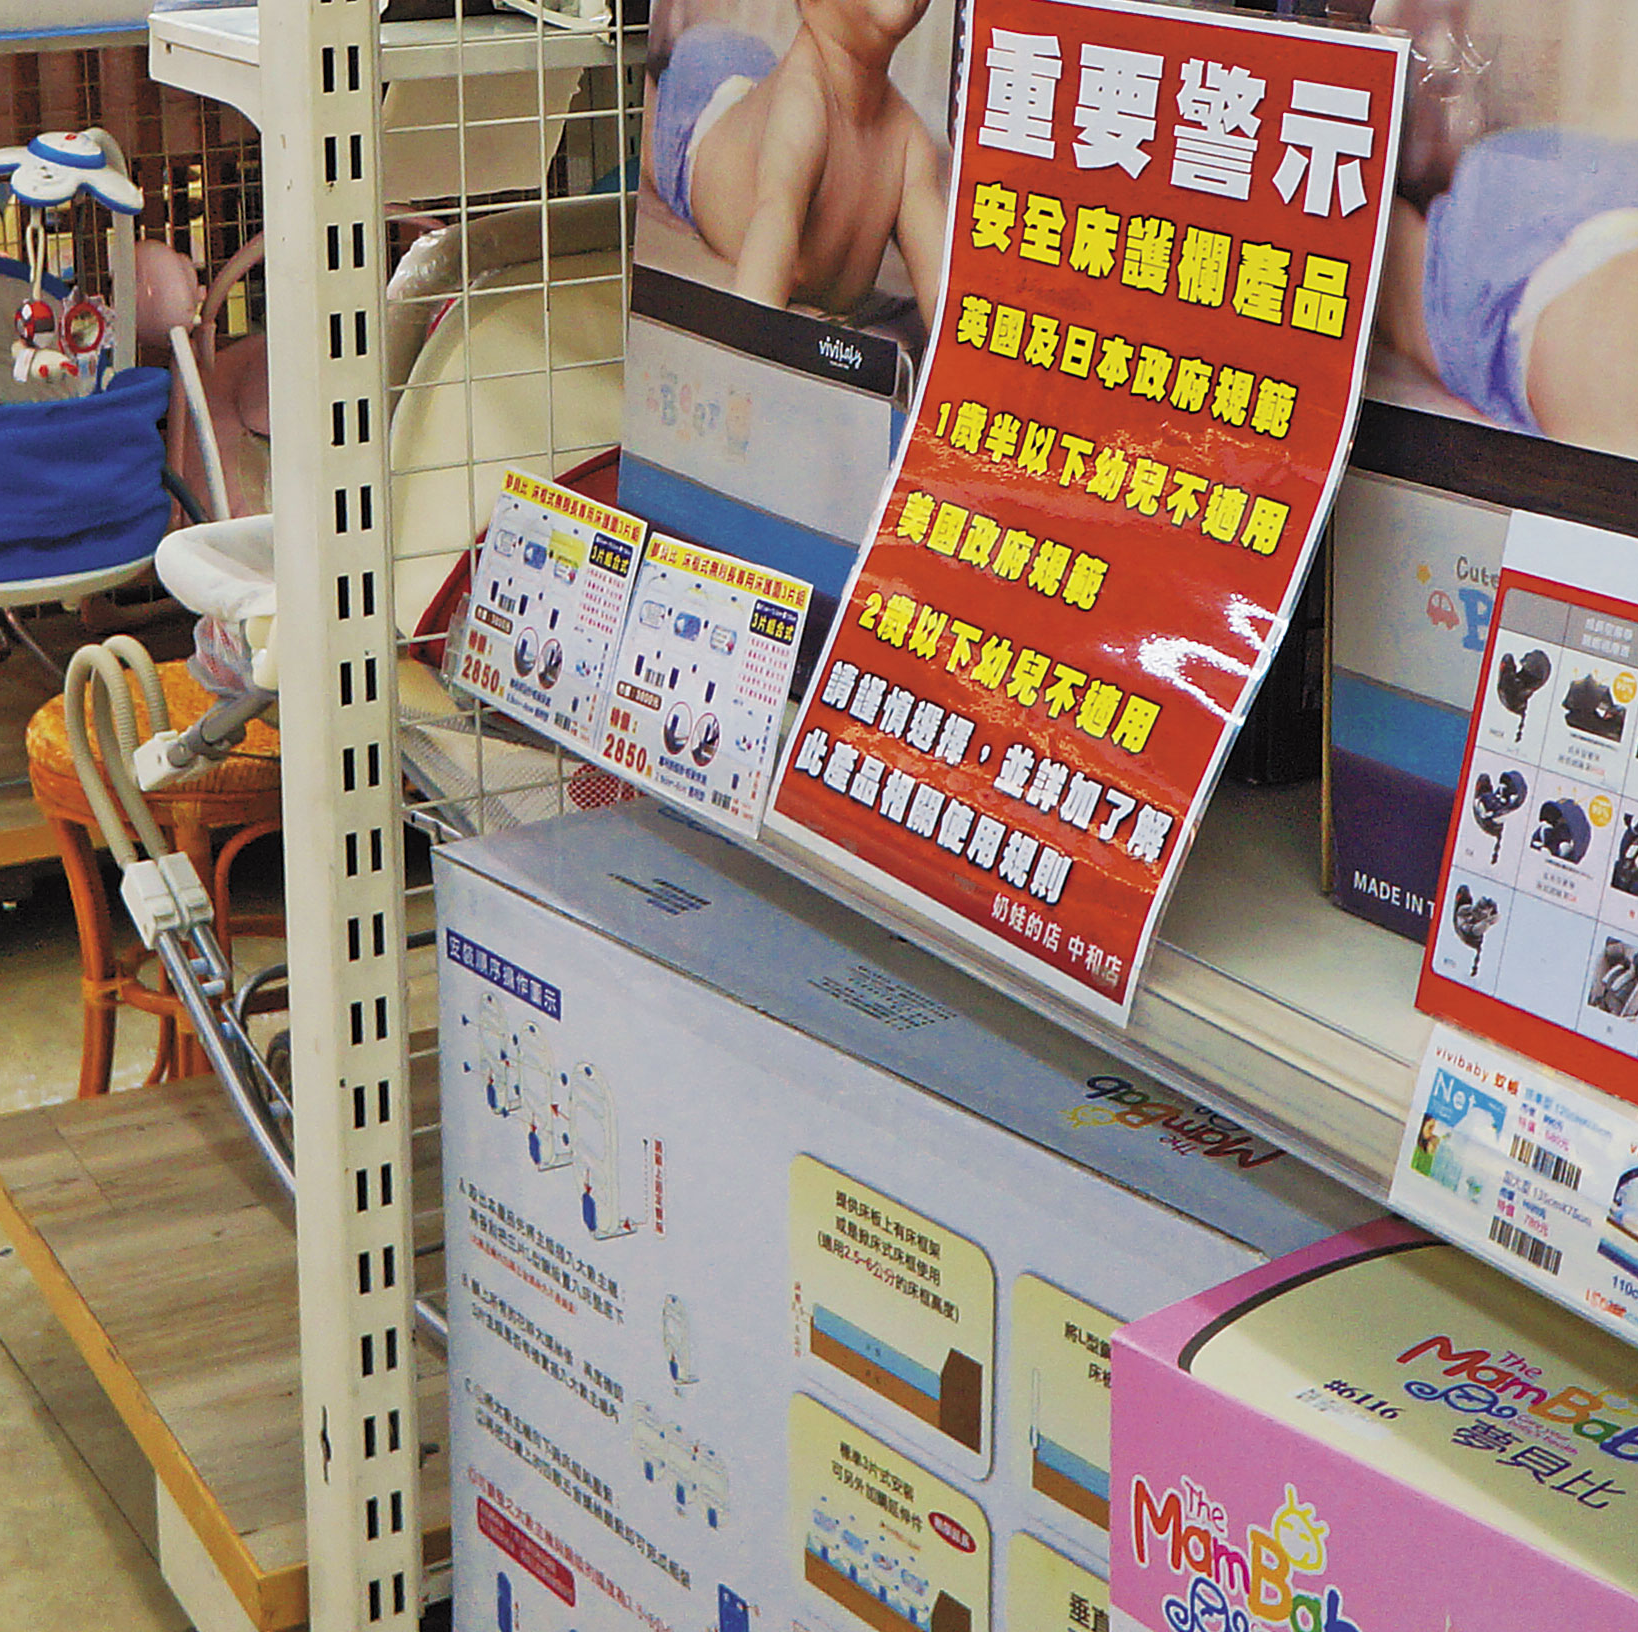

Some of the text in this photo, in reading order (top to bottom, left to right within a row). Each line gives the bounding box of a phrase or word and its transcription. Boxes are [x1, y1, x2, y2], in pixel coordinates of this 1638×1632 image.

[977, 26, 1375, 218] 重要警示
[971, 181, 1351, 338] 安全床護欄產品
[955, 294, 1298, 440] 英國及日本政府規範
[936, 399, 1292, 557] 1歲半以下幼兒不適用
[895, 490, 1110, 611] 美國政府規範
[750, 611, 795, 642] 3片組合式
[857, 590, 1162, 755] 2歲以下幼兒不適用
[820, 659, 1174, 864] 請謹慎選擇，並詳加了解
[794, 726, 1074, 906] 此產品相關使用規則
[990, 891, 1123, 986] 奶娃的店 中和店
[1352, 870, 1401, 903] MADE
[1404, 883, 1424, 909] IN
[1436, 1045, 1490, 1083] vivibaby
[1323, 1378, 1408, 1421] #6116
[1496, 1349, 1544, 1380] The
[1181, 1475, 1226, 1533] The
[1451, 1417, 1627, 1510] 夢貝比
